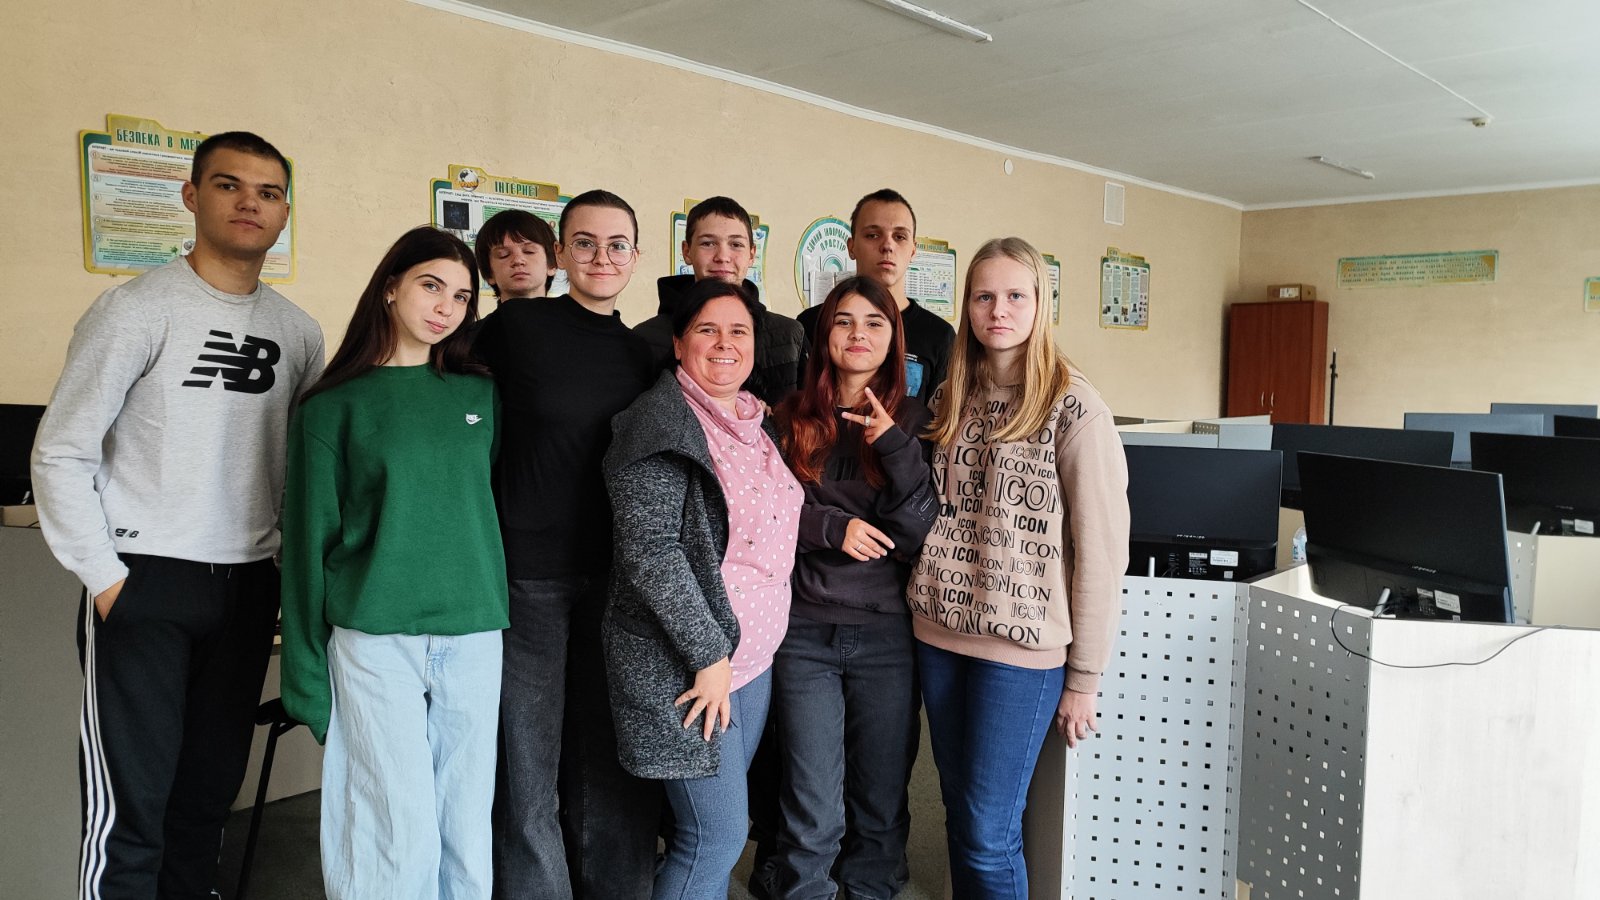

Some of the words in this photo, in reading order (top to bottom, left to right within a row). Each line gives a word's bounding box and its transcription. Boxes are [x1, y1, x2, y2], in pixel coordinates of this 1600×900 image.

[116, 128, 160, 147] БЕЗПЕКА
[167, 136, 173, 148] В
[180, 138, 204, 151] МЕР
[495, 181, 539, 198] ІНТЕРНЕТ
[181, 329, 281, 394] NB
[1062, 393, 1088, 420] ON
[933, 452, 949, 465] ON
[999, 456, 1037, 476] ICON
[969, 470, 984, 482] ICO
[994, 471, 1063, 515] ICON
[939, 503, 958, 519] ON
[985, 506, 1010, 519] ICON
[957, 518, 977, 531] ICON
[1013, 514, 1049, 535] ICON
[945, 527, 980, 545] ICON
[921, 543, 950, 559] CON
[951, 546, 982, 565] ICON
[1019, 540, 1063, 560] ICON
[980, 556, 1005, 571] ICON
[1009, 557, 1046, 578] ICON
[935, 567, 975, 588] ICON
[973, 569, 1011, 594] ICON
[942, 587, 975, 608] ICON
[1010, 582, 1053, 602] ICON
[973, 600, 999, 616] ICON
[1010, 602, 1047, 622] ICON
[986, 620, 1042, 645] ICON
